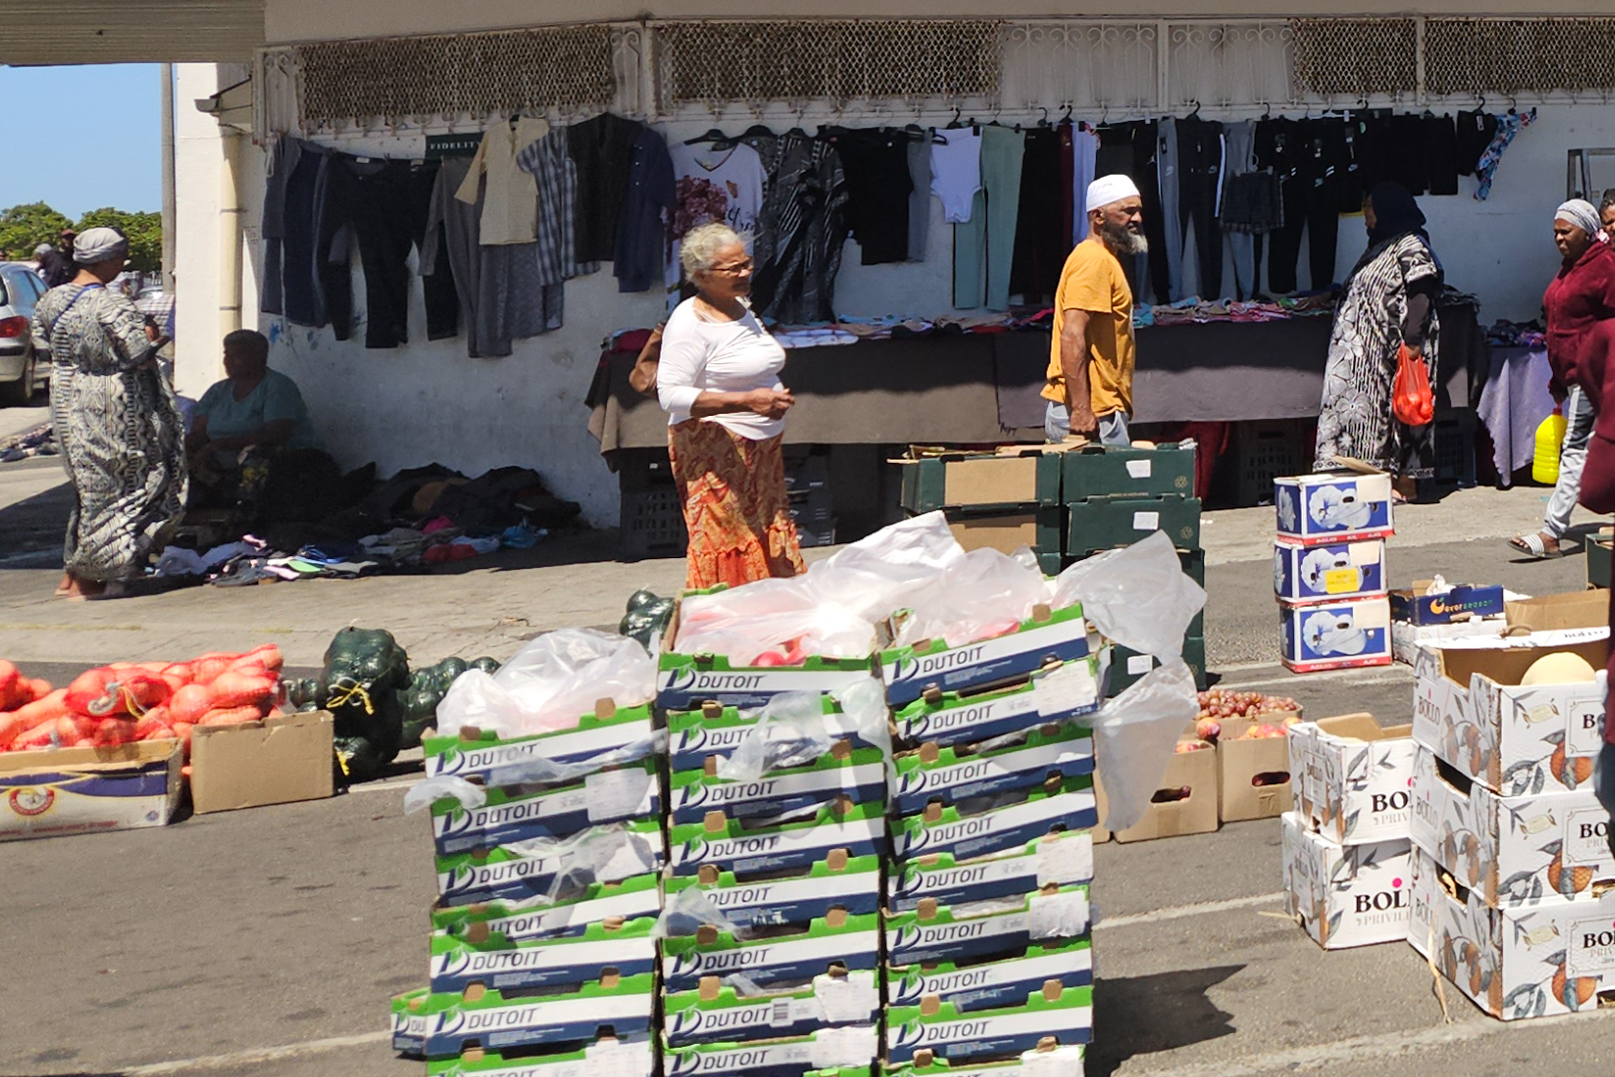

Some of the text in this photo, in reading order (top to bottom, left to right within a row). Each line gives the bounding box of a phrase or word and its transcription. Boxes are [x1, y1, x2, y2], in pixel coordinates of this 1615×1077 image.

[923, 645, 986, 673] DUTOIT
[698, 675, 766, 689] DUTOIT
[933, 704, 996, 730] DUTOIT
[930, 760, 993, 787] DUTOIT
[711, 780, 779, 801] DUTOIT
[476, 800, 546, 826] DUTOIT
[933, 816, 995, 843] DUTOIT
[712, 836, 779, 857] DUTOIT
[480, 858, 546, 883] DUTOIT
[925, 866, 989, 888] DUTOIT
[1354, 888, 1411, 913] BOL
[488, 913, 548, 935] UTOIT
[924, 922, 986, 943] DUTOIT
[473, 950, 544, 971] DUTOIT
[704, 948, 772, 970] DUTOIT
[928, 968, 992, 993] DUTOIT
[468, 1008, 540, 1029] DUTOIT
[705, 1007, 771, 1029] DUTOIT
[927, 1020, 991, 1041] DUTOIT
[703, 1050, 769, 1070] DUTOIT
